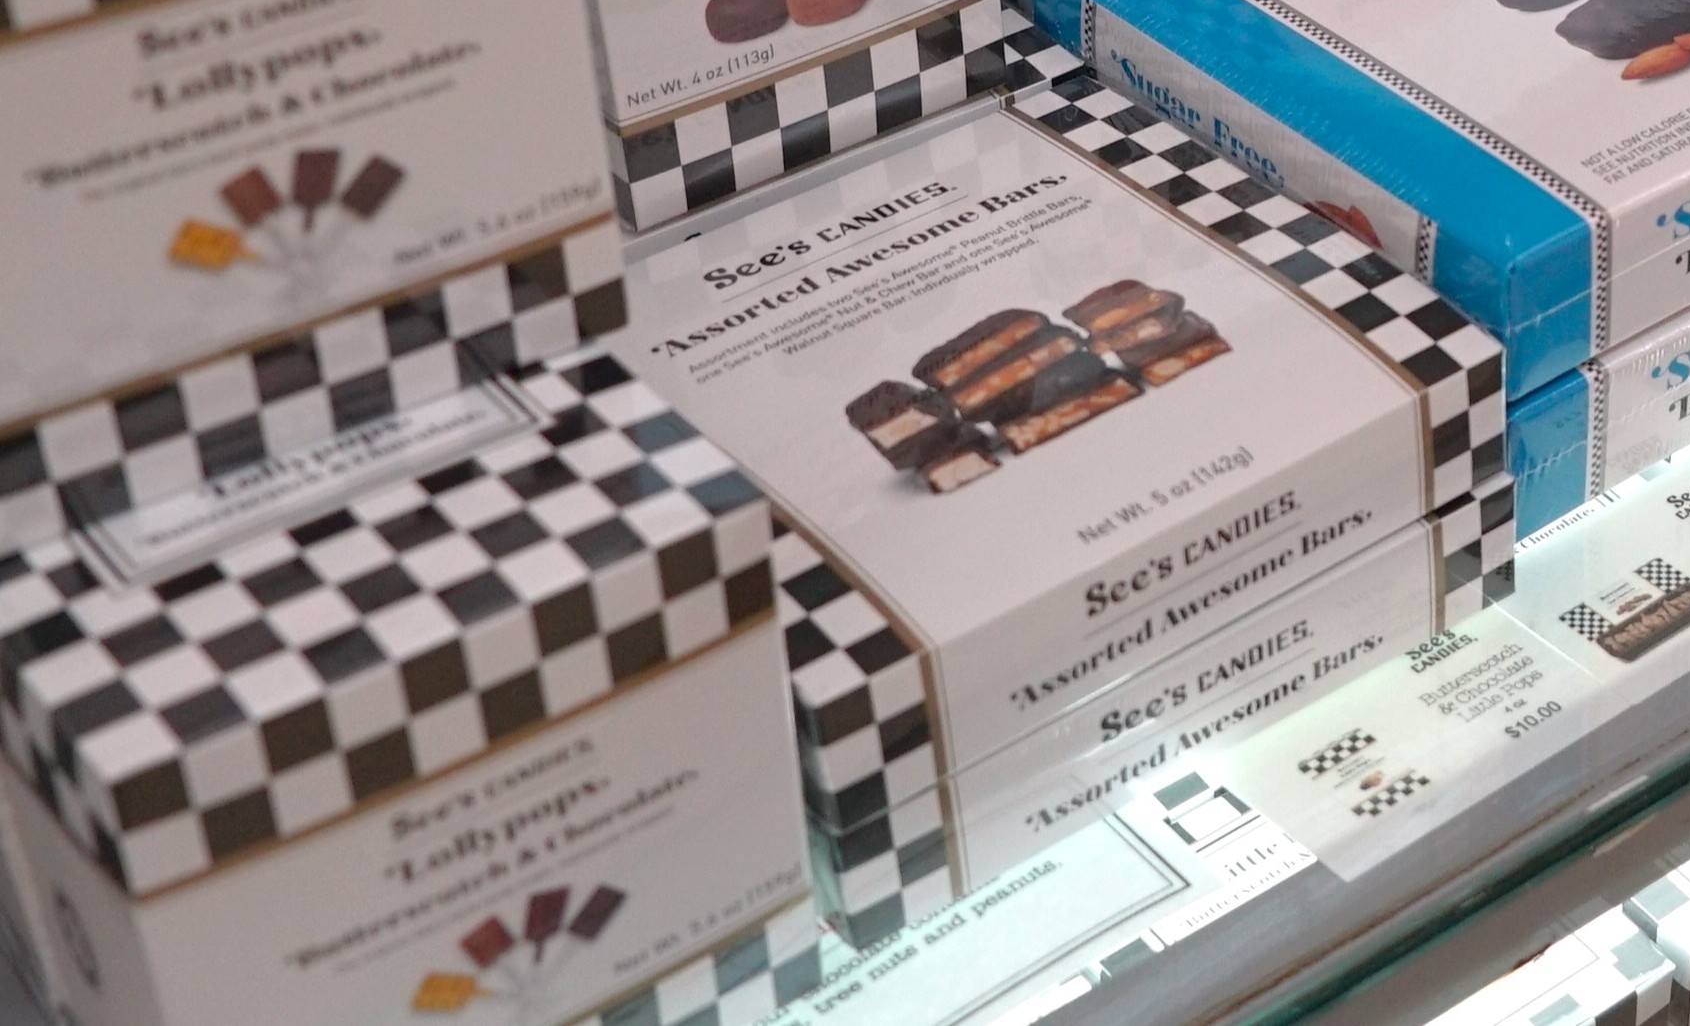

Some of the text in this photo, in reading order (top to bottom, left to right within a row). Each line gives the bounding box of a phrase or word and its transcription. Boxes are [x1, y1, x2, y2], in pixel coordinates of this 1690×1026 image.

[626, 43, 777, 108] Net Wt. 4 oz (113g)
[1580, 151, 1604, 169] NOT
[1606, 148, 1617, 157] A
[1613, 133, 1643, 154] LOW
[1641, 112, 1690, 140] CALORIE
[1591, 159, 1619, 177] SEE
[1617, 128, 1680, 168] NUTRITION
[1602, 169, 1629, 187] FAT
[1626, 156, 1655, 176] AND
[650, 273, 820, 358] Assorted
[825, 210, 980, 285] Awesome
[703, 240, 812, 290] See's
[915, 266, 941, 283] Bar
[943, 254, 969, 270] and
[969, 244, 994, 259] one
[992, 228, 1030, 248] See's
[689, 208, 1050, 375] Assortment includes See's Peanut Brittle
[1075, 444, 1256, 546] Net Wt. 5 oz (142g)
[1083, 554, 1176, 619] See's
[1008, 618, 1154, 712] Assorted
[1159, 549, 1296, 634] Awesome
[1416, 642, 1525, 708] Butterscotch
[1438, 655, 1535, 715] & Chocolate
[1457, 670, 1544, 724] Little Pops
[1098, 682, 1188, 744] See's
[1504, 700, 1563, 740] $10.00
[1023, 742, 1167, 833] Assorted
[1172, 673, 1308, 761] Awesome
[812, 858, 1064, 1015] tree nuts and peanuts.
